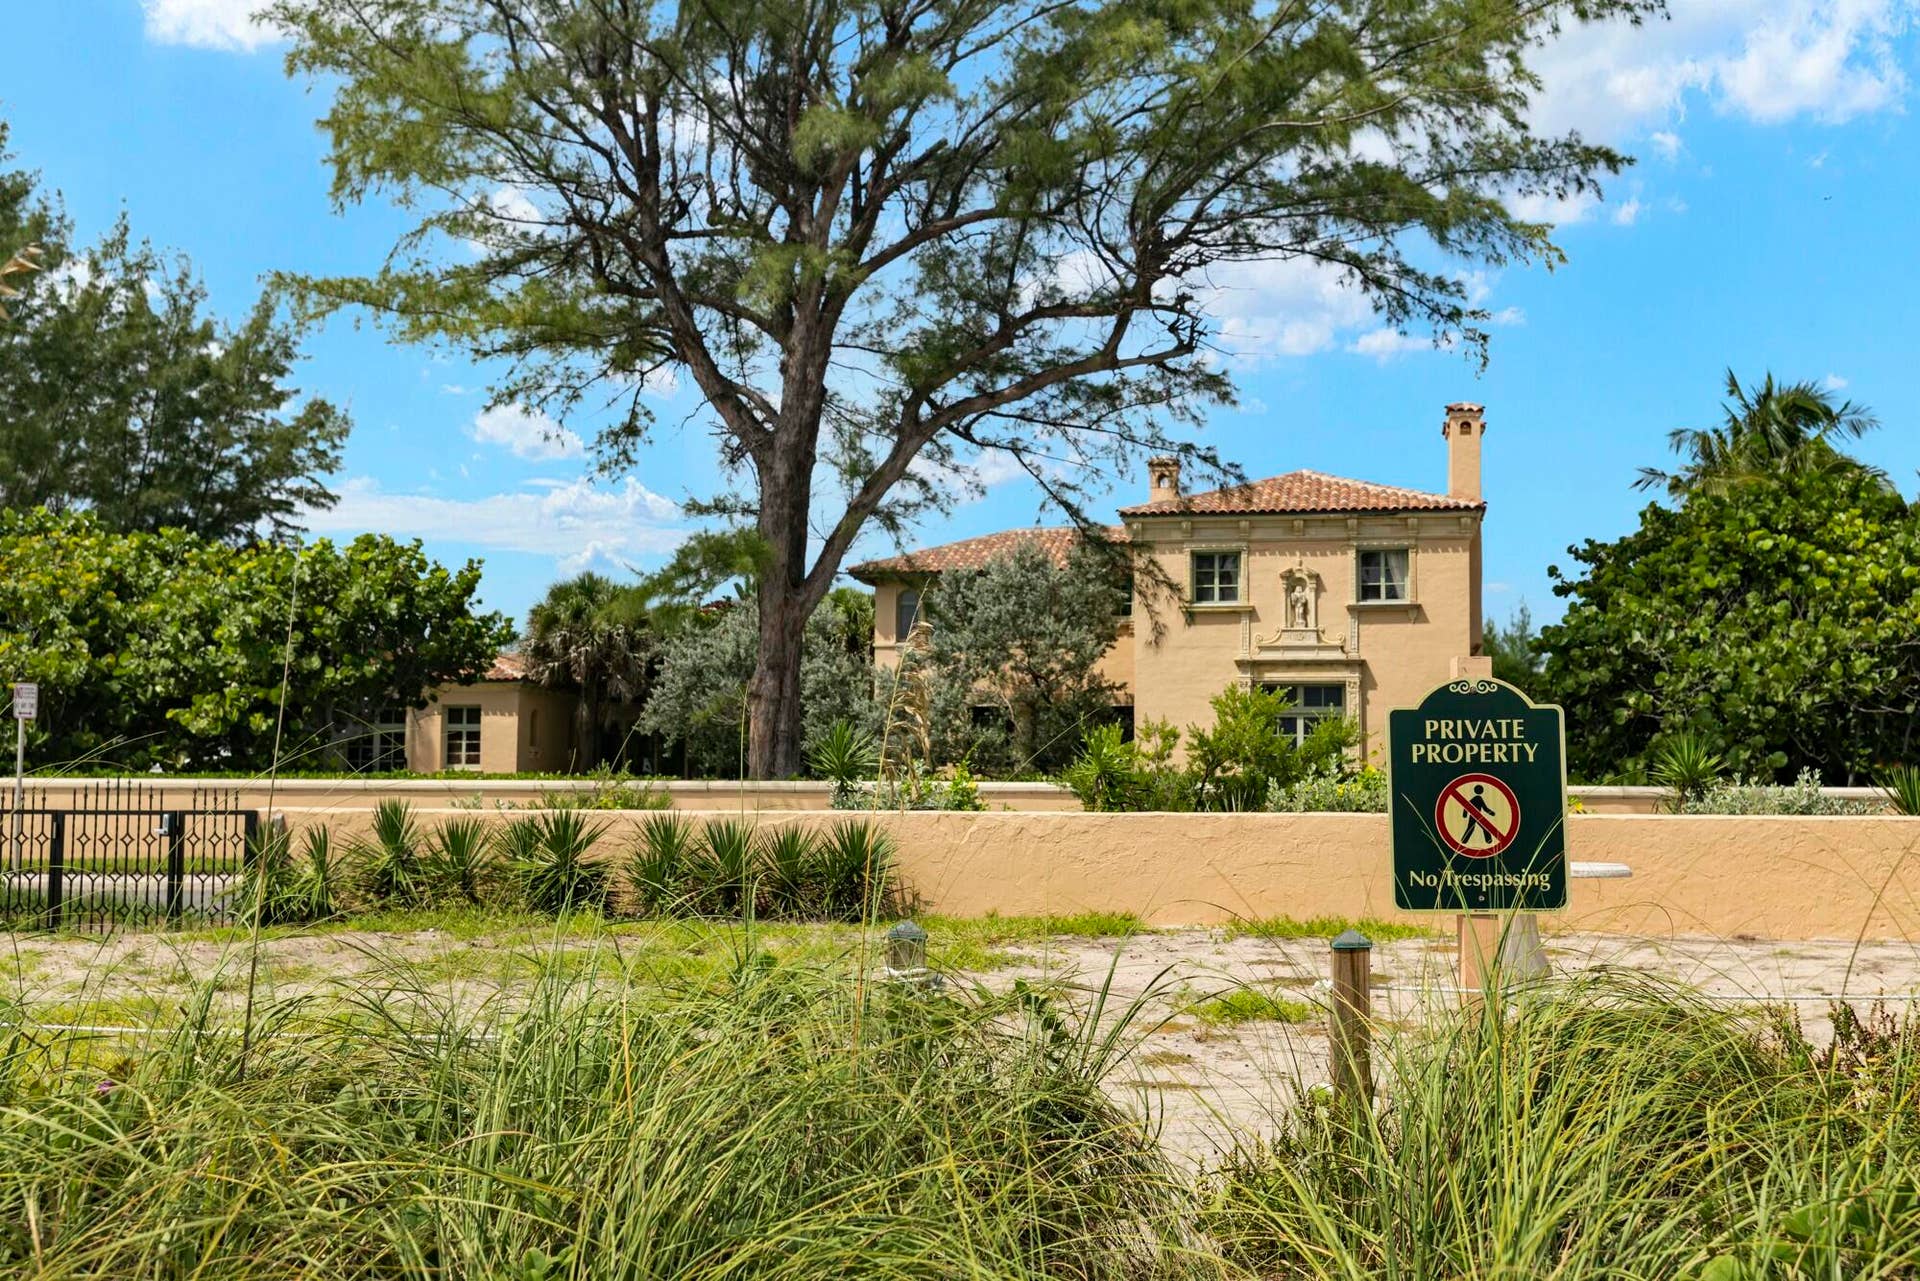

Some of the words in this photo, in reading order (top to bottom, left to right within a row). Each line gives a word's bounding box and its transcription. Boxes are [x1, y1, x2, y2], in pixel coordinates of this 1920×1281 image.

[1425, 719, 1525, 739] PRIVATE
[1411, 743, 1539, 763] PROPERTY
[1409, 870, 1438, 887] No
[1444, 868, 1551, 892] Trespassing
